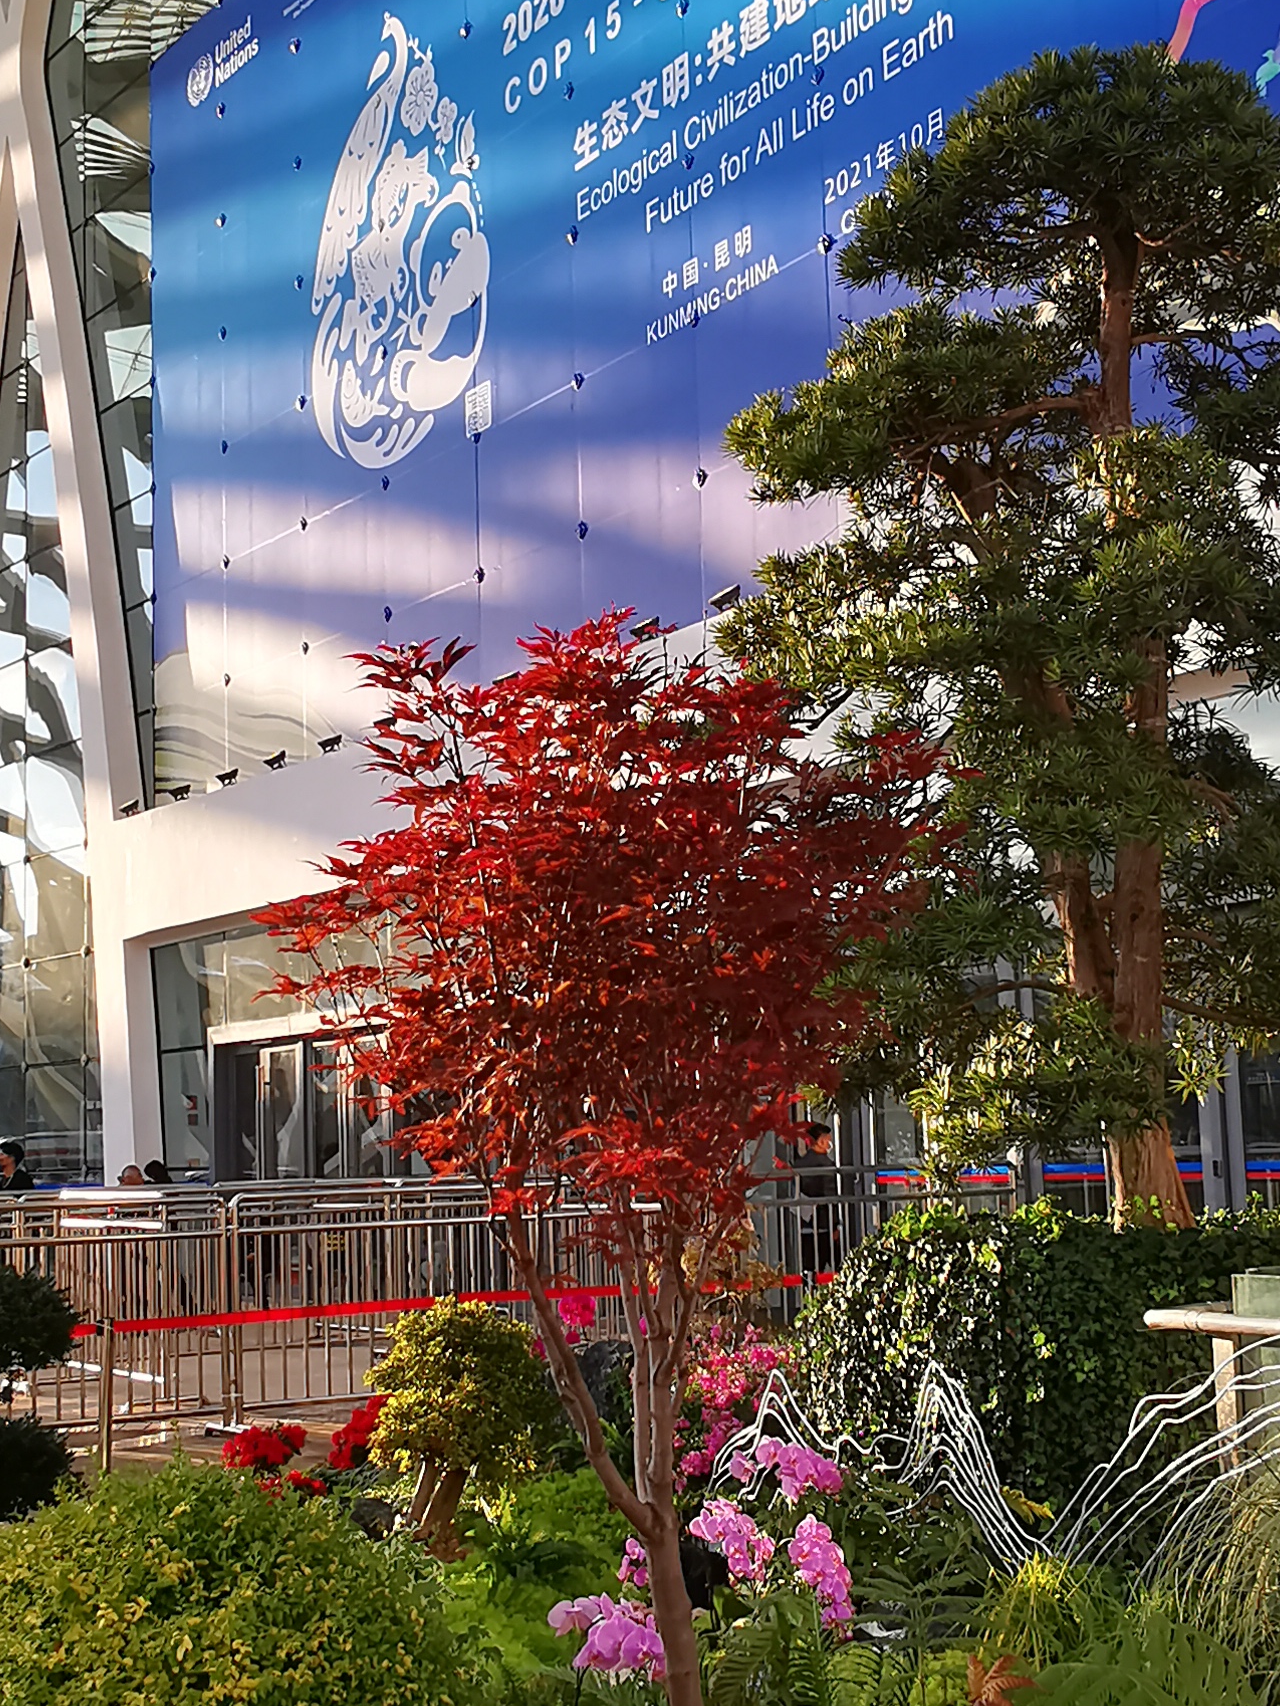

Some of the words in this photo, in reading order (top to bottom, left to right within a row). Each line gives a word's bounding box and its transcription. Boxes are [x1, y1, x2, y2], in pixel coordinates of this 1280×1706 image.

[215, 14, 251, 63] United
[215, 37, 259, 88] Nations
[645, 172, 714, 234] Future
[719, 146, 750, 187] for
[755, 115, 789, 165] All
[792, 92, 835, 141] Life
[842, 67, 874, 105] on
[882, 10, 954, 81] Earth
[576, 129, 677, 222] Ecological
